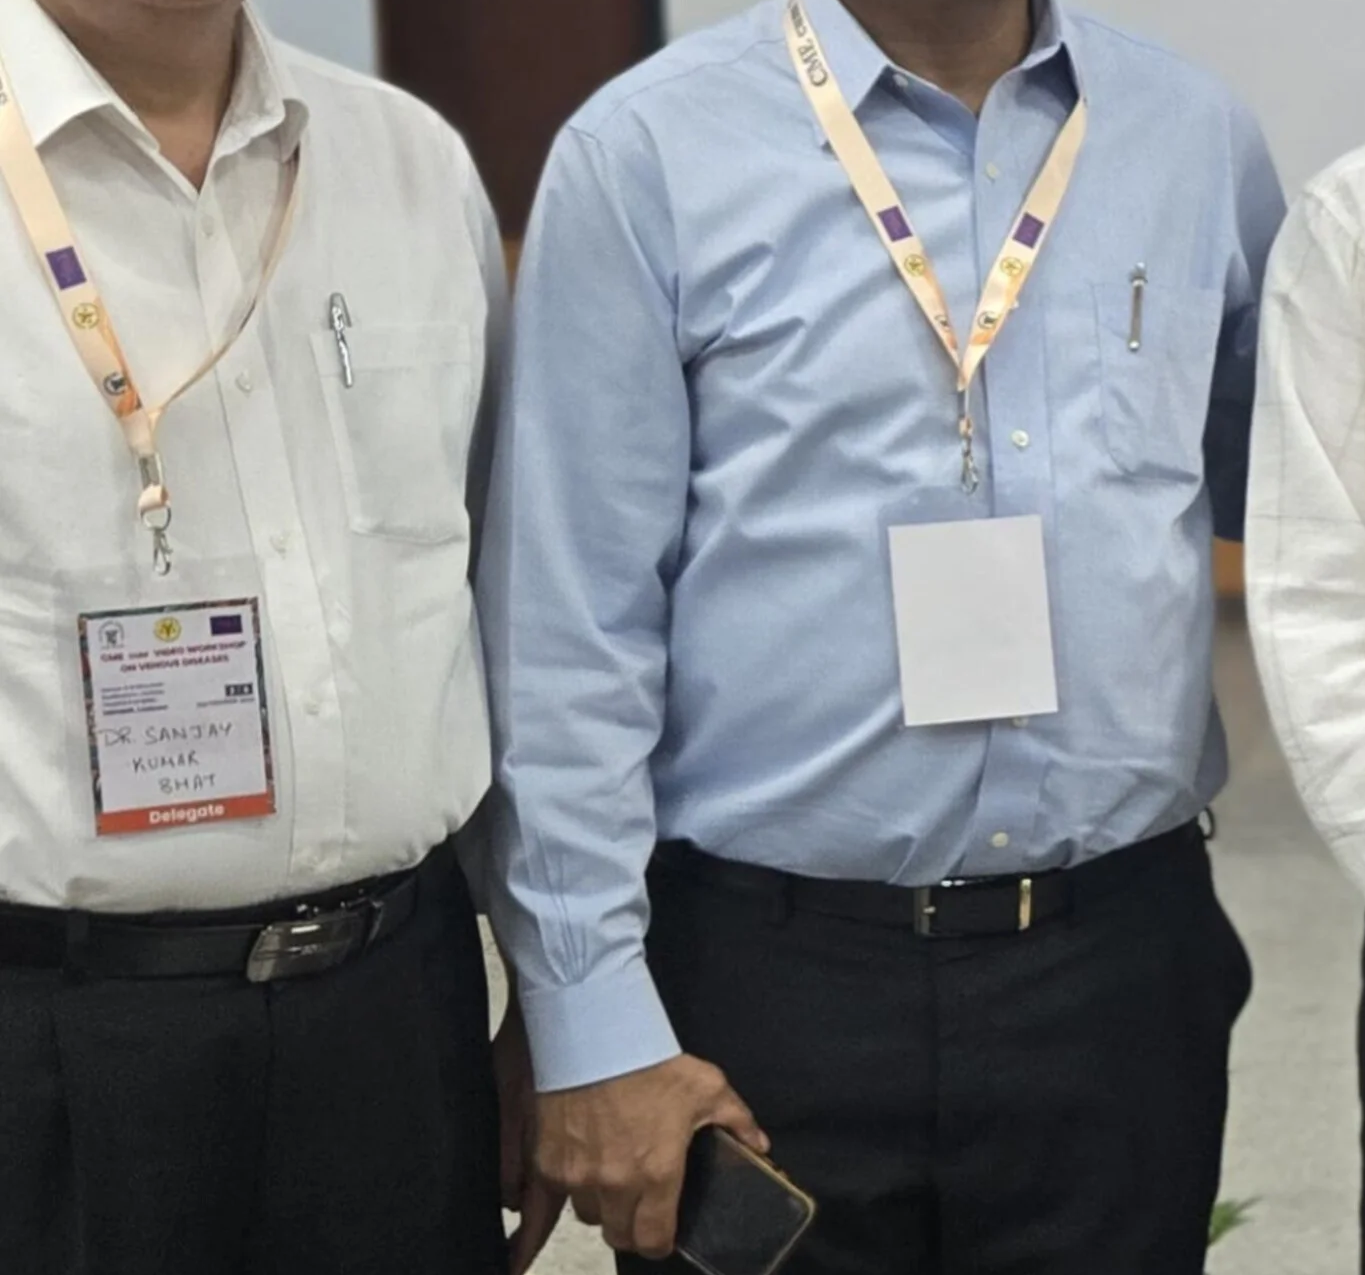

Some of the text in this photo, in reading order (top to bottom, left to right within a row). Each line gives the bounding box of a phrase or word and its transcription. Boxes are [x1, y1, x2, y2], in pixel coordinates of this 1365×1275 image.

[145, 722, 232, 746] SANJAY
[132, 750, 199, 773] KUMAR
[149, 803, 225, 825] Delegate
